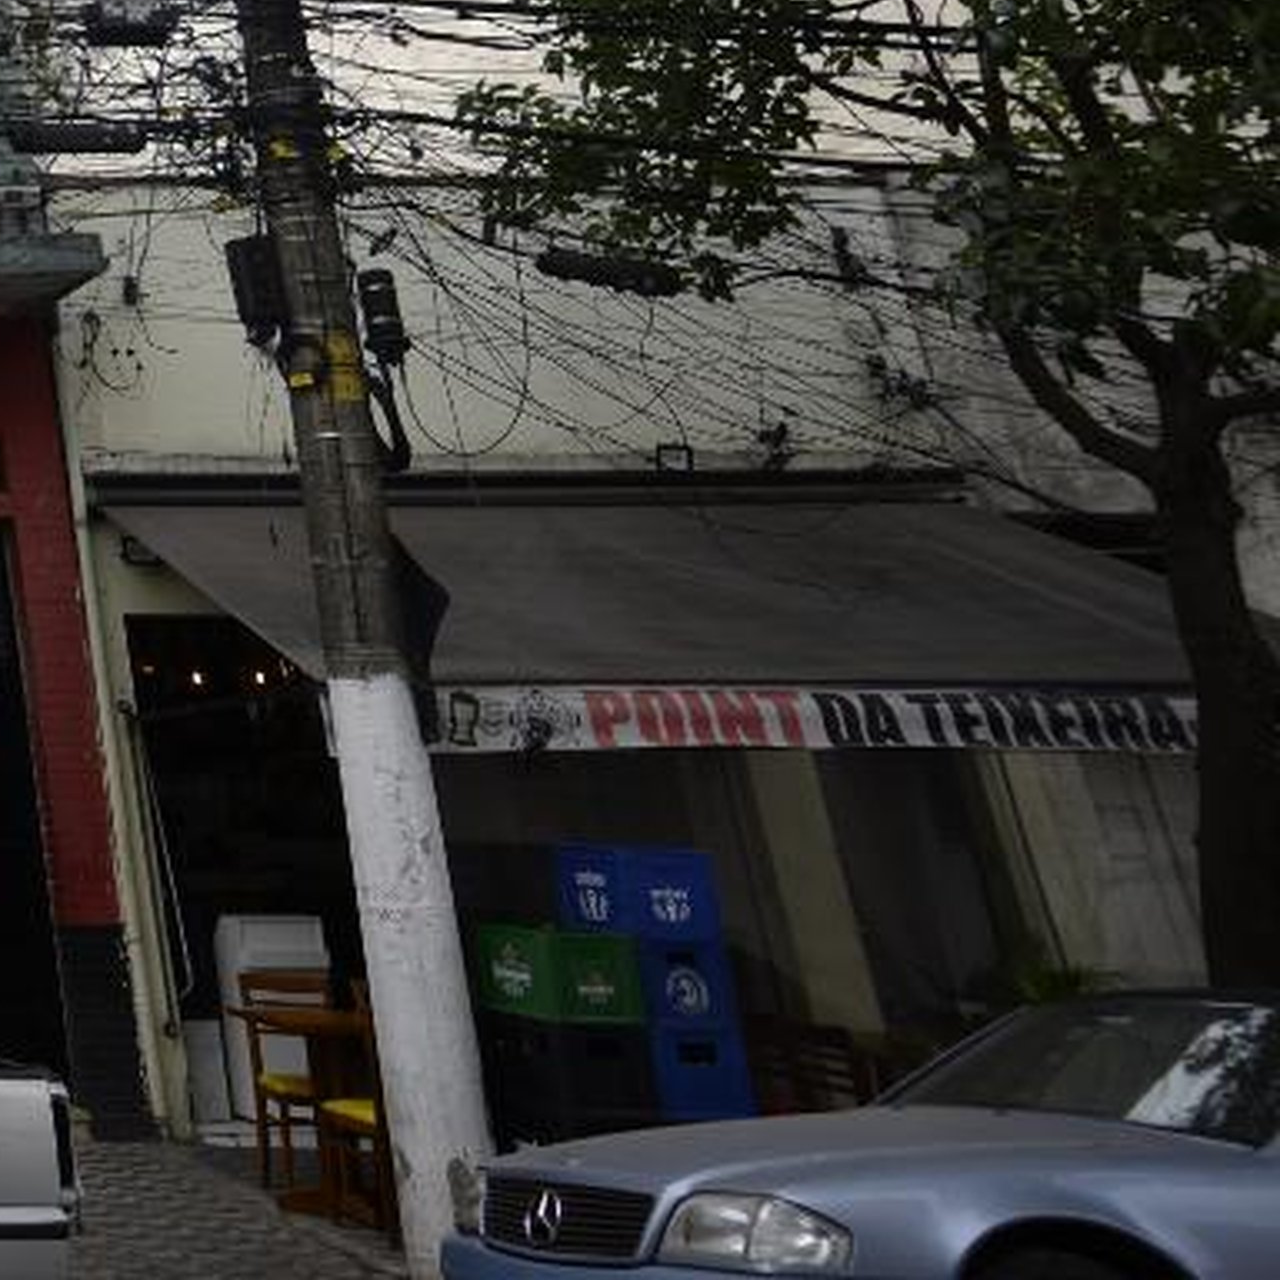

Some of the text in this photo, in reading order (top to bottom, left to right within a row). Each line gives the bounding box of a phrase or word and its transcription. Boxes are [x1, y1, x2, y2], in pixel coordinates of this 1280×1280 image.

[586, 690, 1196, 751] POINT DA TEIXEIRA
